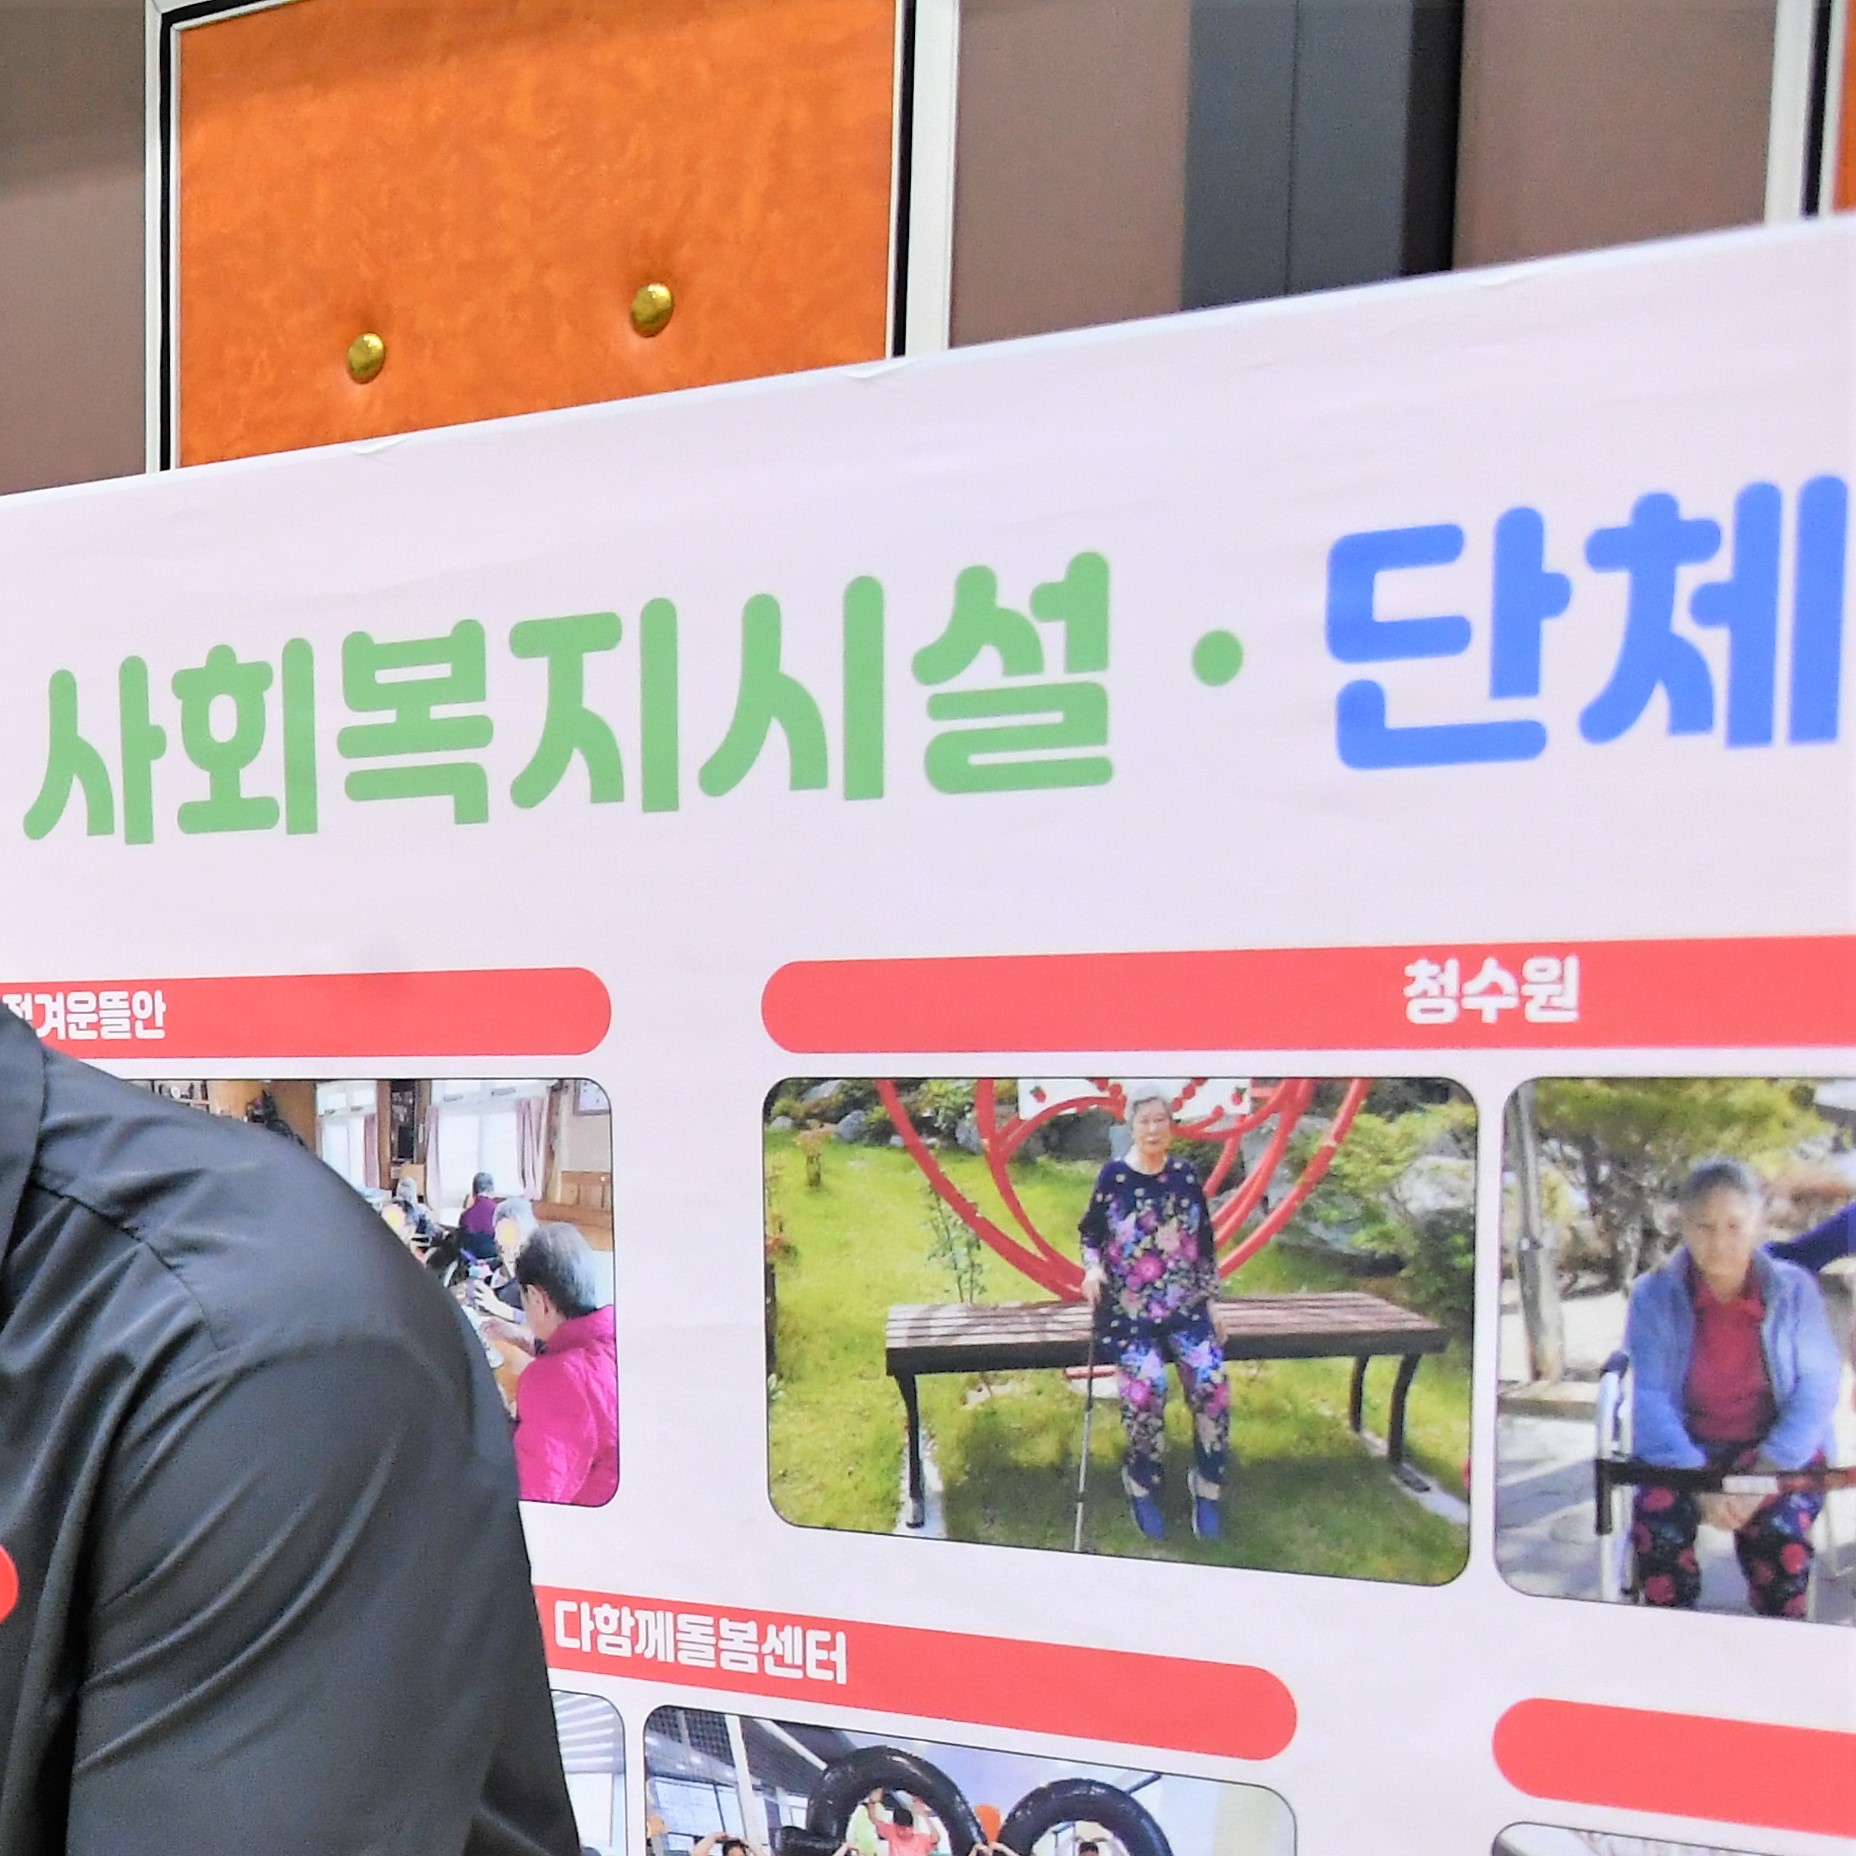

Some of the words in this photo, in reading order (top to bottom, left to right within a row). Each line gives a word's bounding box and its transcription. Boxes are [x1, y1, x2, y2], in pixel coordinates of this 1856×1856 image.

[25, 552, 1113, 843] 사회복지시설
[1324, 473, 1852, 772] 단체
[1402, 956, 1579, 1025] 청수원
[552, 1599, 849, 1685] 다함께돌봄센터
